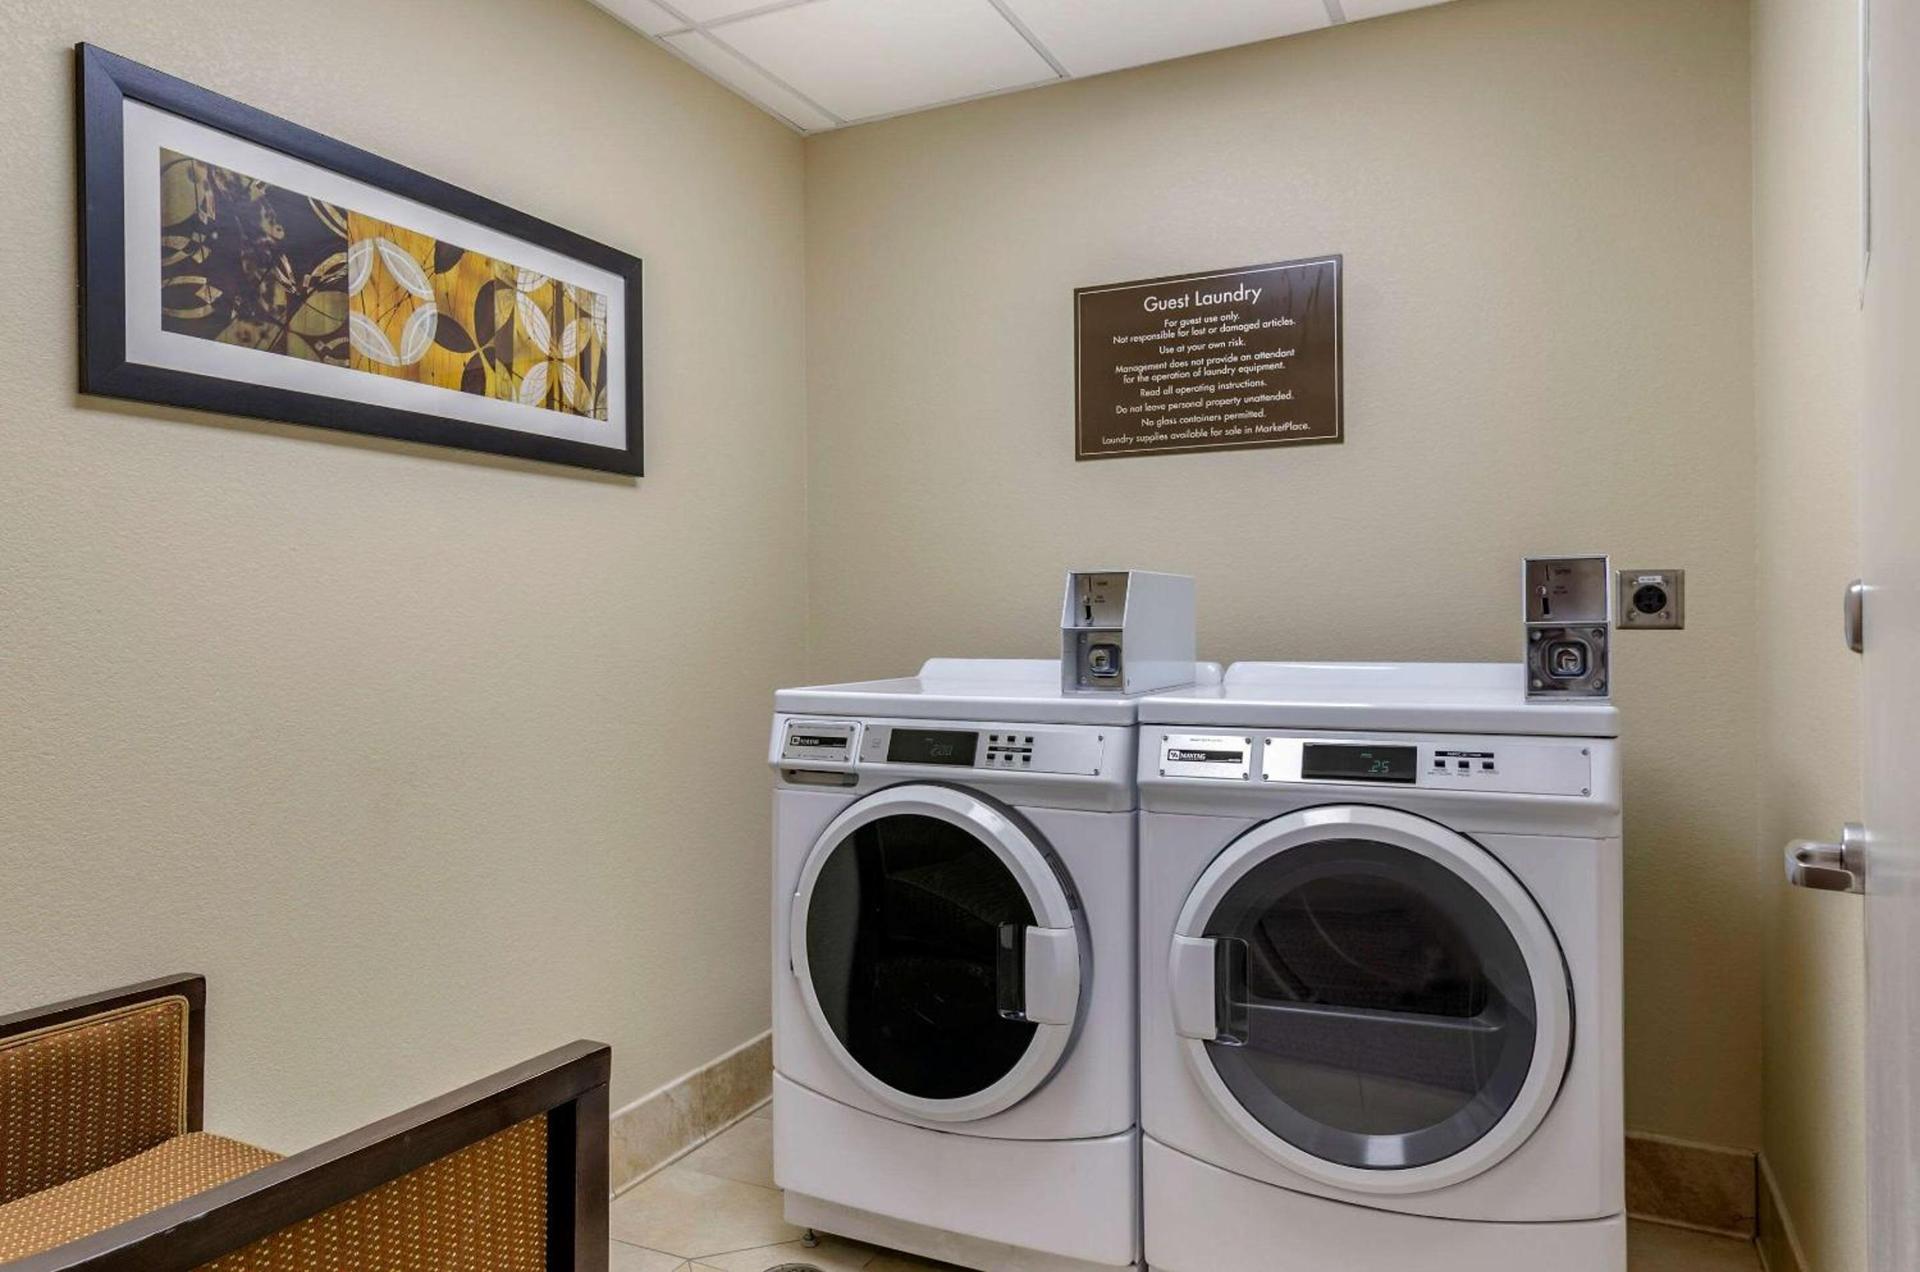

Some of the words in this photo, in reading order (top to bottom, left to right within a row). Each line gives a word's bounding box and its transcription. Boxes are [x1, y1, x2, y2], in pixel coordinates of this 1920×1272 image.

[1143, 294, 1189, 312] Guest
[1194, 282, 1262, 306] Laundry
[1113, 336, 1128, 344] Not
[1130, 330, 1175, 343] responsible
[1177, 328, 1189, 337] for
[1191, 327, 1206, 336] lost
[1220, 320, 1260, 332] damaged
[1262, 316, 1296, 328] articles.
[1164, 319, 1178, 328] For
[1180, 317, 1202, 329] guest
[1220, 311, 1240, 322] only.
[1159, 346, 1174, 354] Use
[1176, 344, 1185, 352] at
[1187, 343, 1206, 354] your
[1208, 341, 1225, 349] own
[1228, 337, 1246, 347] risk.
[1115, 362, 1167, 374] Management
[1169, 359, 1188, 368] does
[1191, 358, 1204, 366] not
[1206, 353, 1238, 366] provide
[1240, 354, 1251, 362] an
[1254, 348, 1295, 360] attendant
[1123, 374, 1135, 384] for
[1137, 372, 1149, 382] the
[1151, 370, 1190, 383] operation
[1192, 367, 1201, 377] of
[1203, 364, 1236, 376] laundry
[1238, 361, 1286, 374] equipment.
[1140, 386, 1160, 396] Read
[1163, 385, 1173, 395] all
[1175, 383, 1215, 396] operating
[1218, 379, 1267, 390] instructions.
[1115, 405, 1128, 414] Do
[1130, 404, 1142, 413] not
[1144, 402, 1165, 412] leave
[1168, 398, 1203, 411] personal
[1206, 396, 1241, 408] property
[1243, 390, 1295, 404] unattended.
[1141, 418, 1154, 427] No
[1156, 416, 1177, 428] glass
[1180, 412, 1222, 424] containers
[1224, 408, 1267, 422] permitted.
[1102, 434, 1134, 444] Laundry
[1136, 432, 1168, 443] supplies
[1170, 428, 1208, 440] available
[1210, 427, 1222, 437] for
[1225, 425, 1242, 436] sale
[1244, 426, 1252, 434] in
[1255, 420, 1311, 433] MarketPlace.
